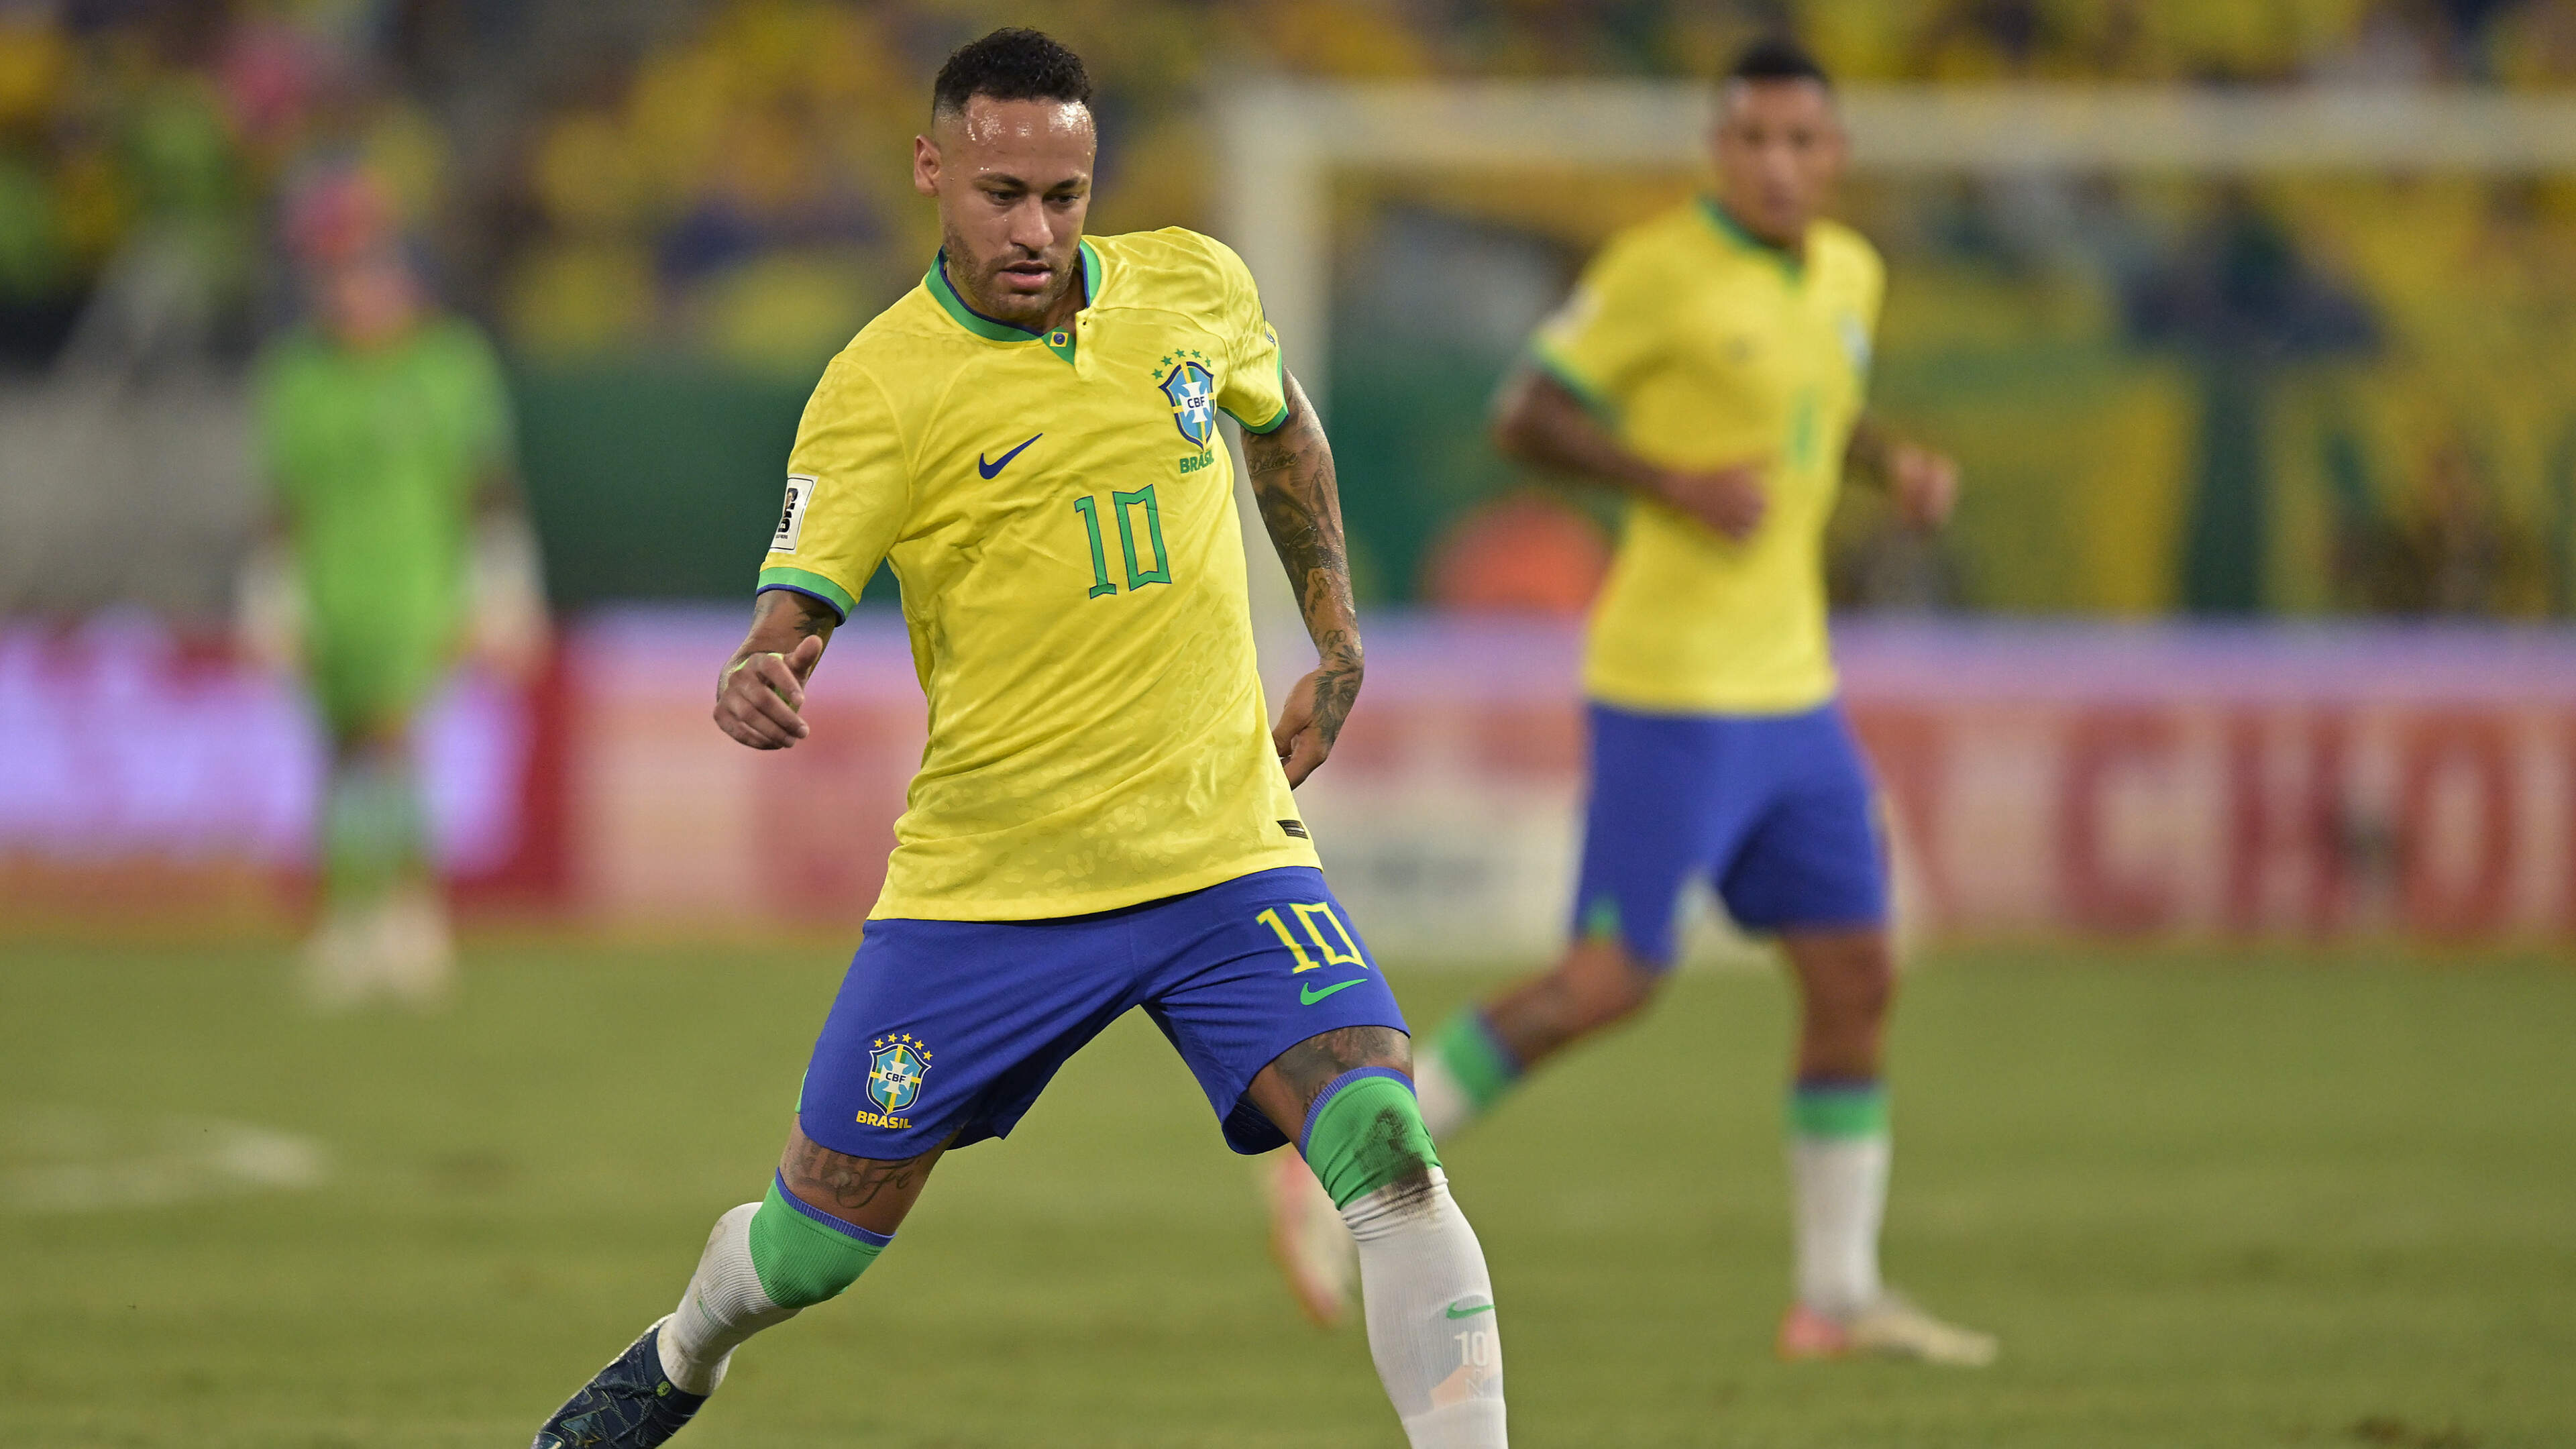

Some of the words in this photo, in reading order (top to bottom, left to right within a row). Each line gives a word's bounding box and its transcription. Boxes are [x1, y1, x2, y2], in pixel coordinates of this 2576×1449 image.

[1187, 396, 1205, 408] CBF
[1179, 449, 1215, 474] BRASIL
[1074, 484, 1172, 599] 10
[1255, 902, 1369, 974] 10
[885, 1072, 906, 1083] CBF
[856, 1110, 912, 1129] BRASIL
[1454, 1330, 1490, 1368] 10
